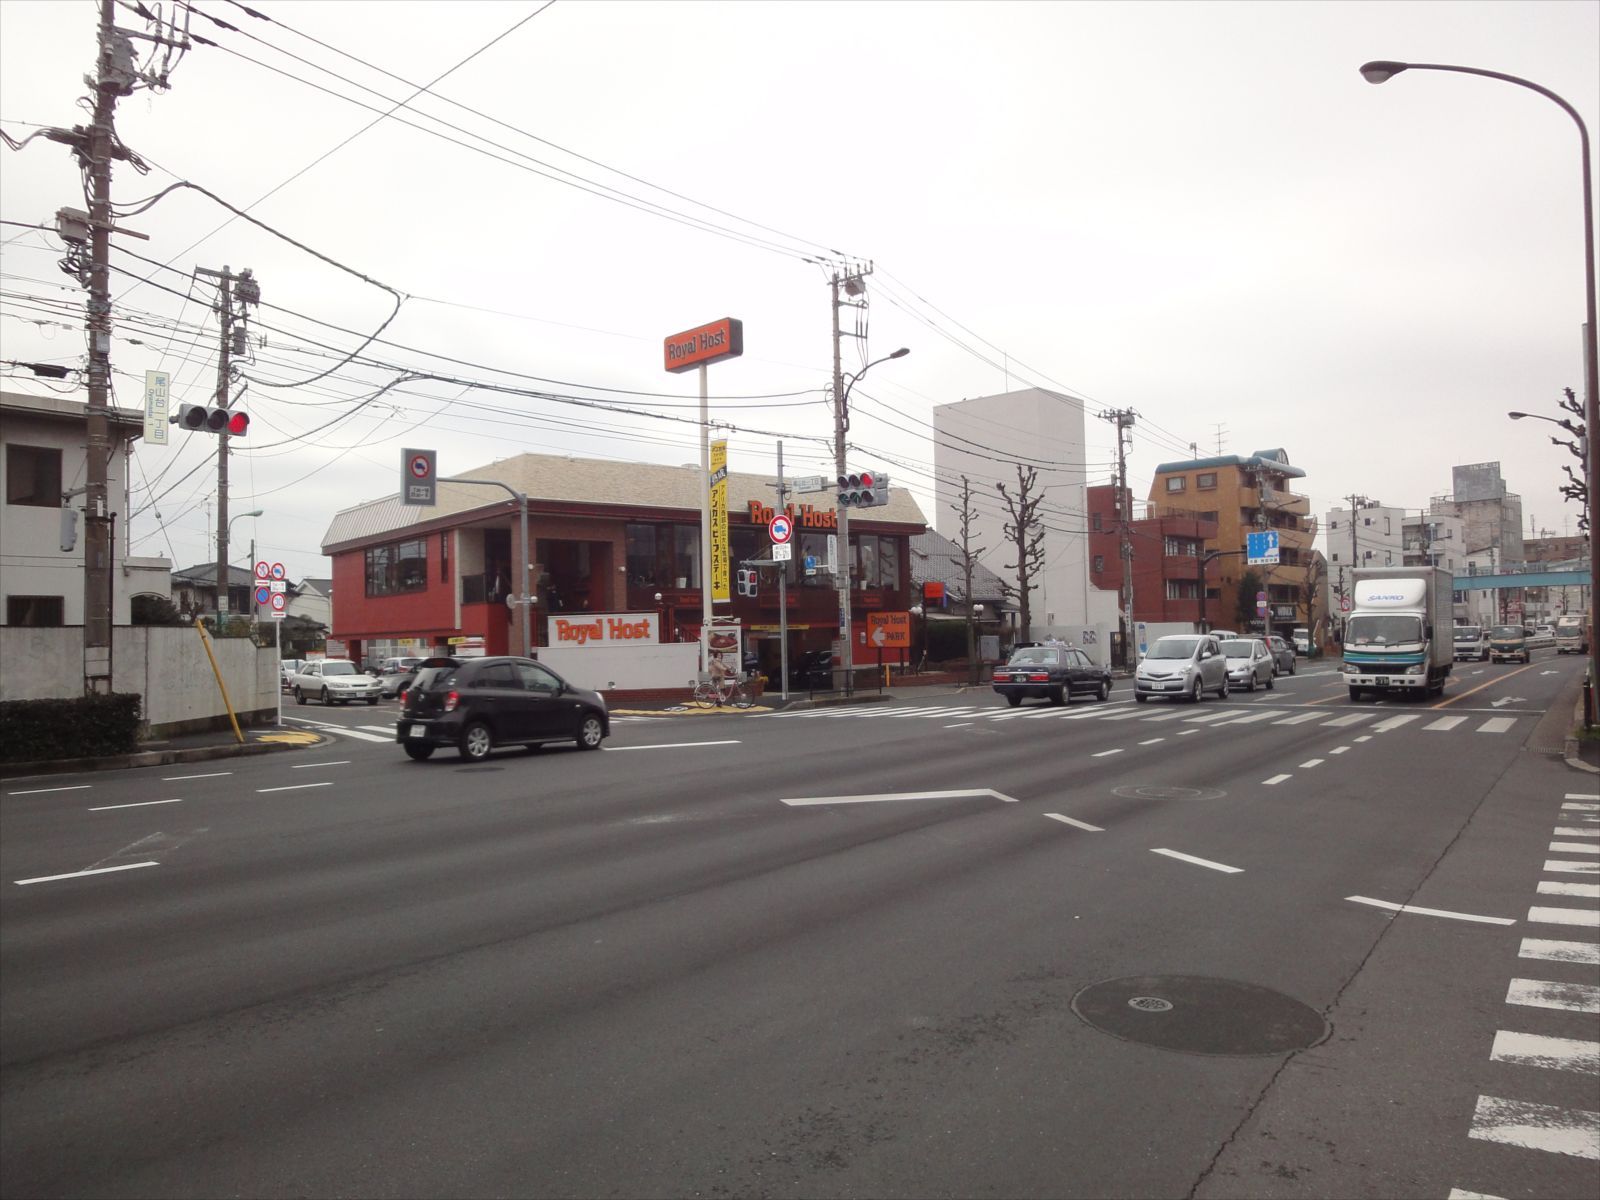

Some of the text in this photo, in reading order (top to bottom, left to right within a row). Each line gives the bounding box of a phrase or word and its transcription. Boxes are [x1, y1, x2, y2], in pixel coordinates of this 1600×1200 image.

[668, 328, 725, 360] Royal Host
[154, 376, 166, 439] 尾山台一丁目
[748, 500, 838, 528] Roal Host
[274, 597, 283, 607] 30
[556, 618, 650, 644] Royal Host
[871, 615, 906, 626] Royal Host
[886, 632, 905, 640] PARK
